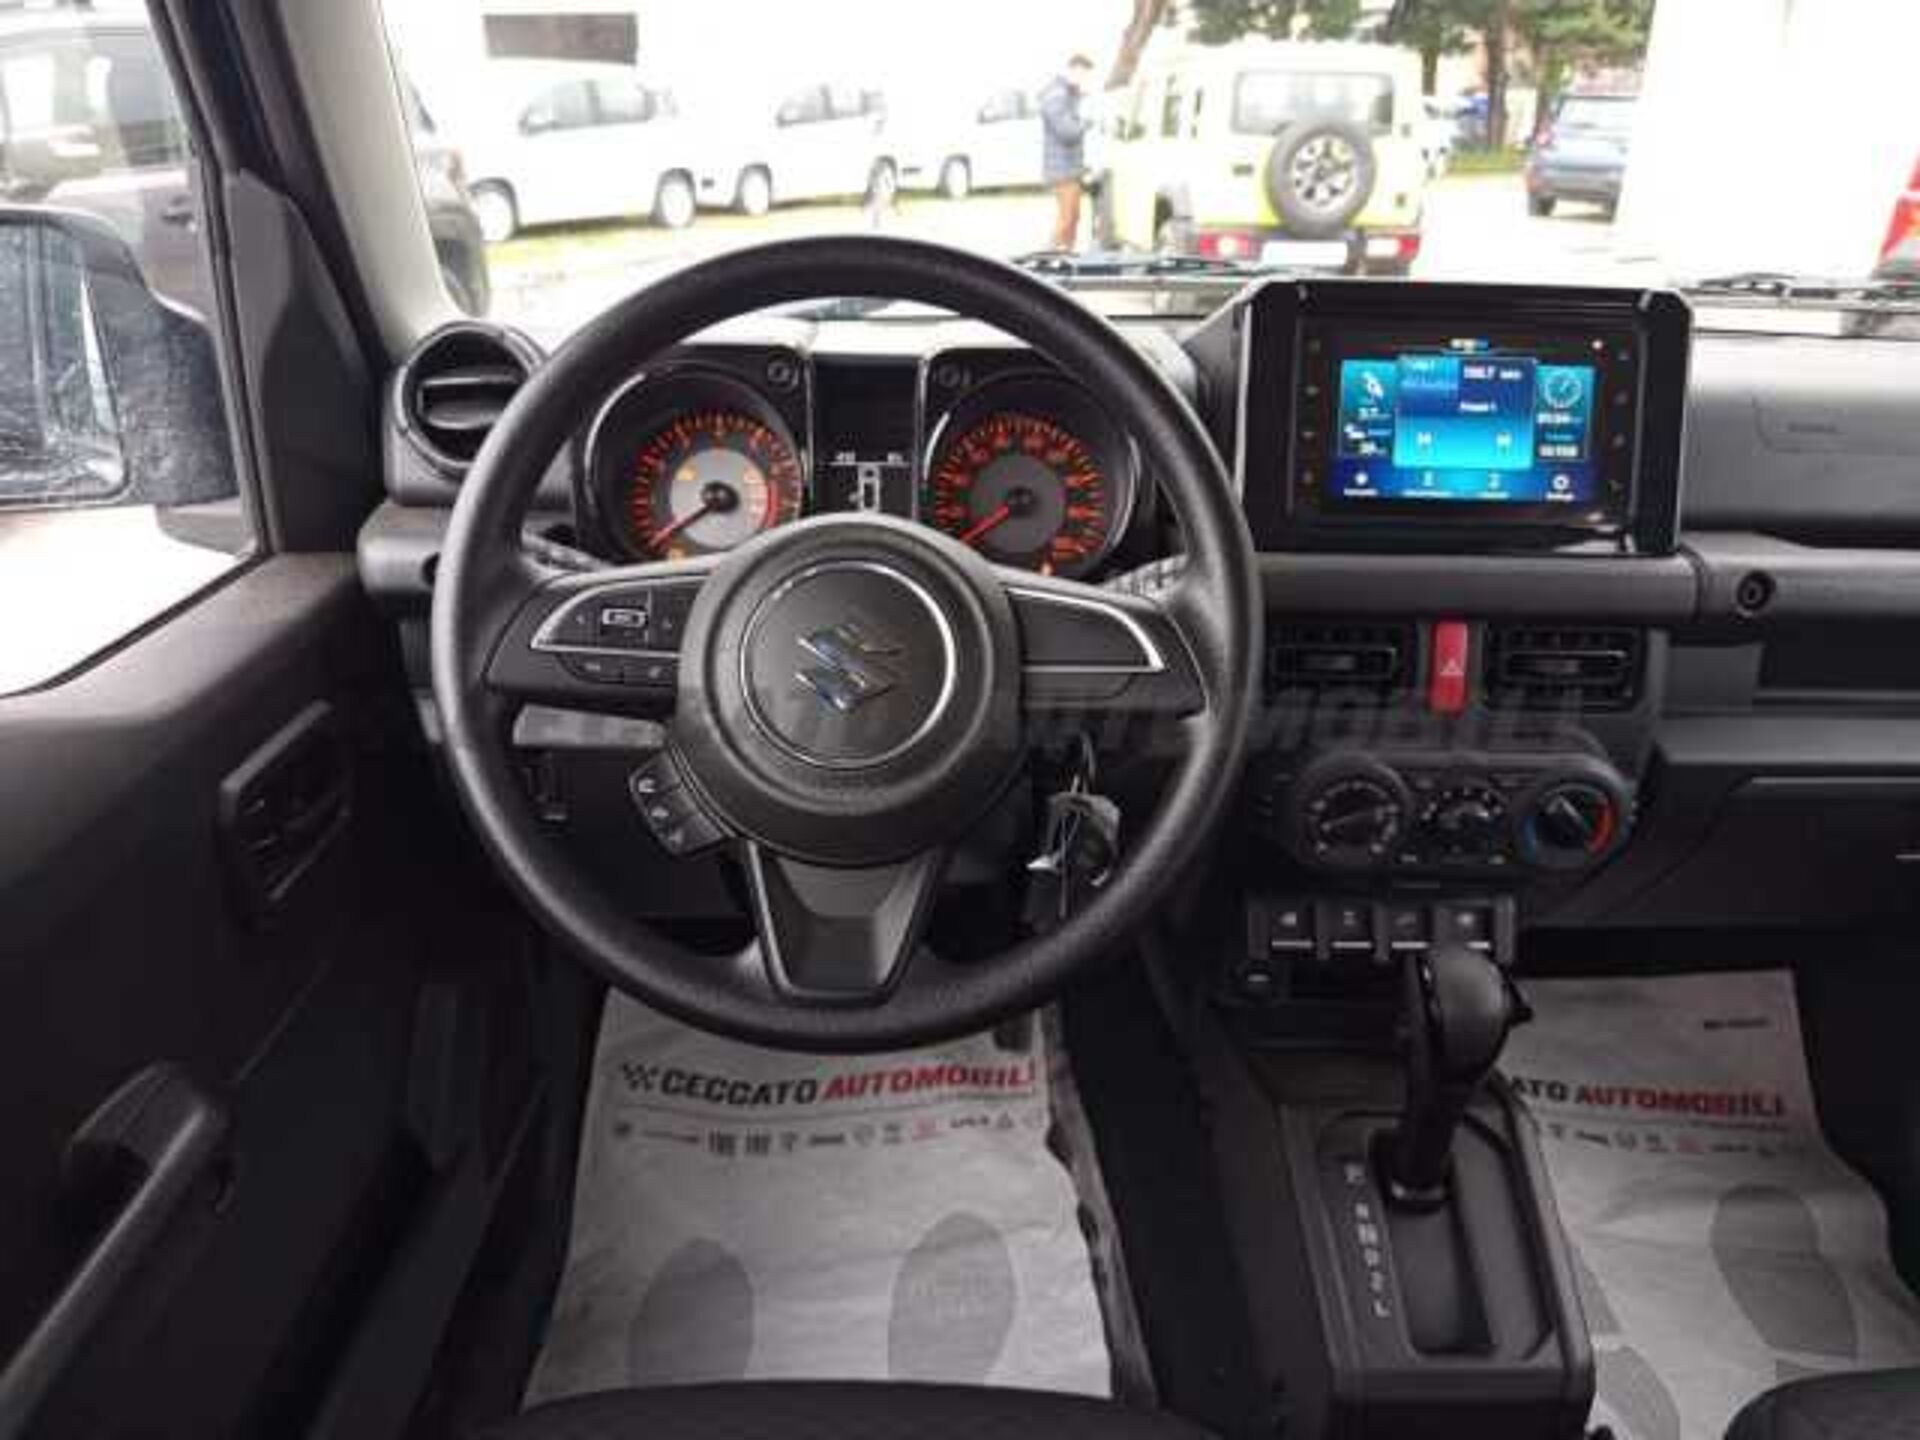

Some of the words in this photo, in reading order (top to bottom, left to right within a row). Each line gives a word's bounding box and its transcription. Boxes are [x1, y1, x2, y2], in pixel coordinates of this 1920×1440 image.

[660, 1069, 818, 1107] CECCATO
[821, 1058, 1036, 1101] AUTOMOBILI
[1573, 1083, 1784, 1118] AUTOMOBILI
